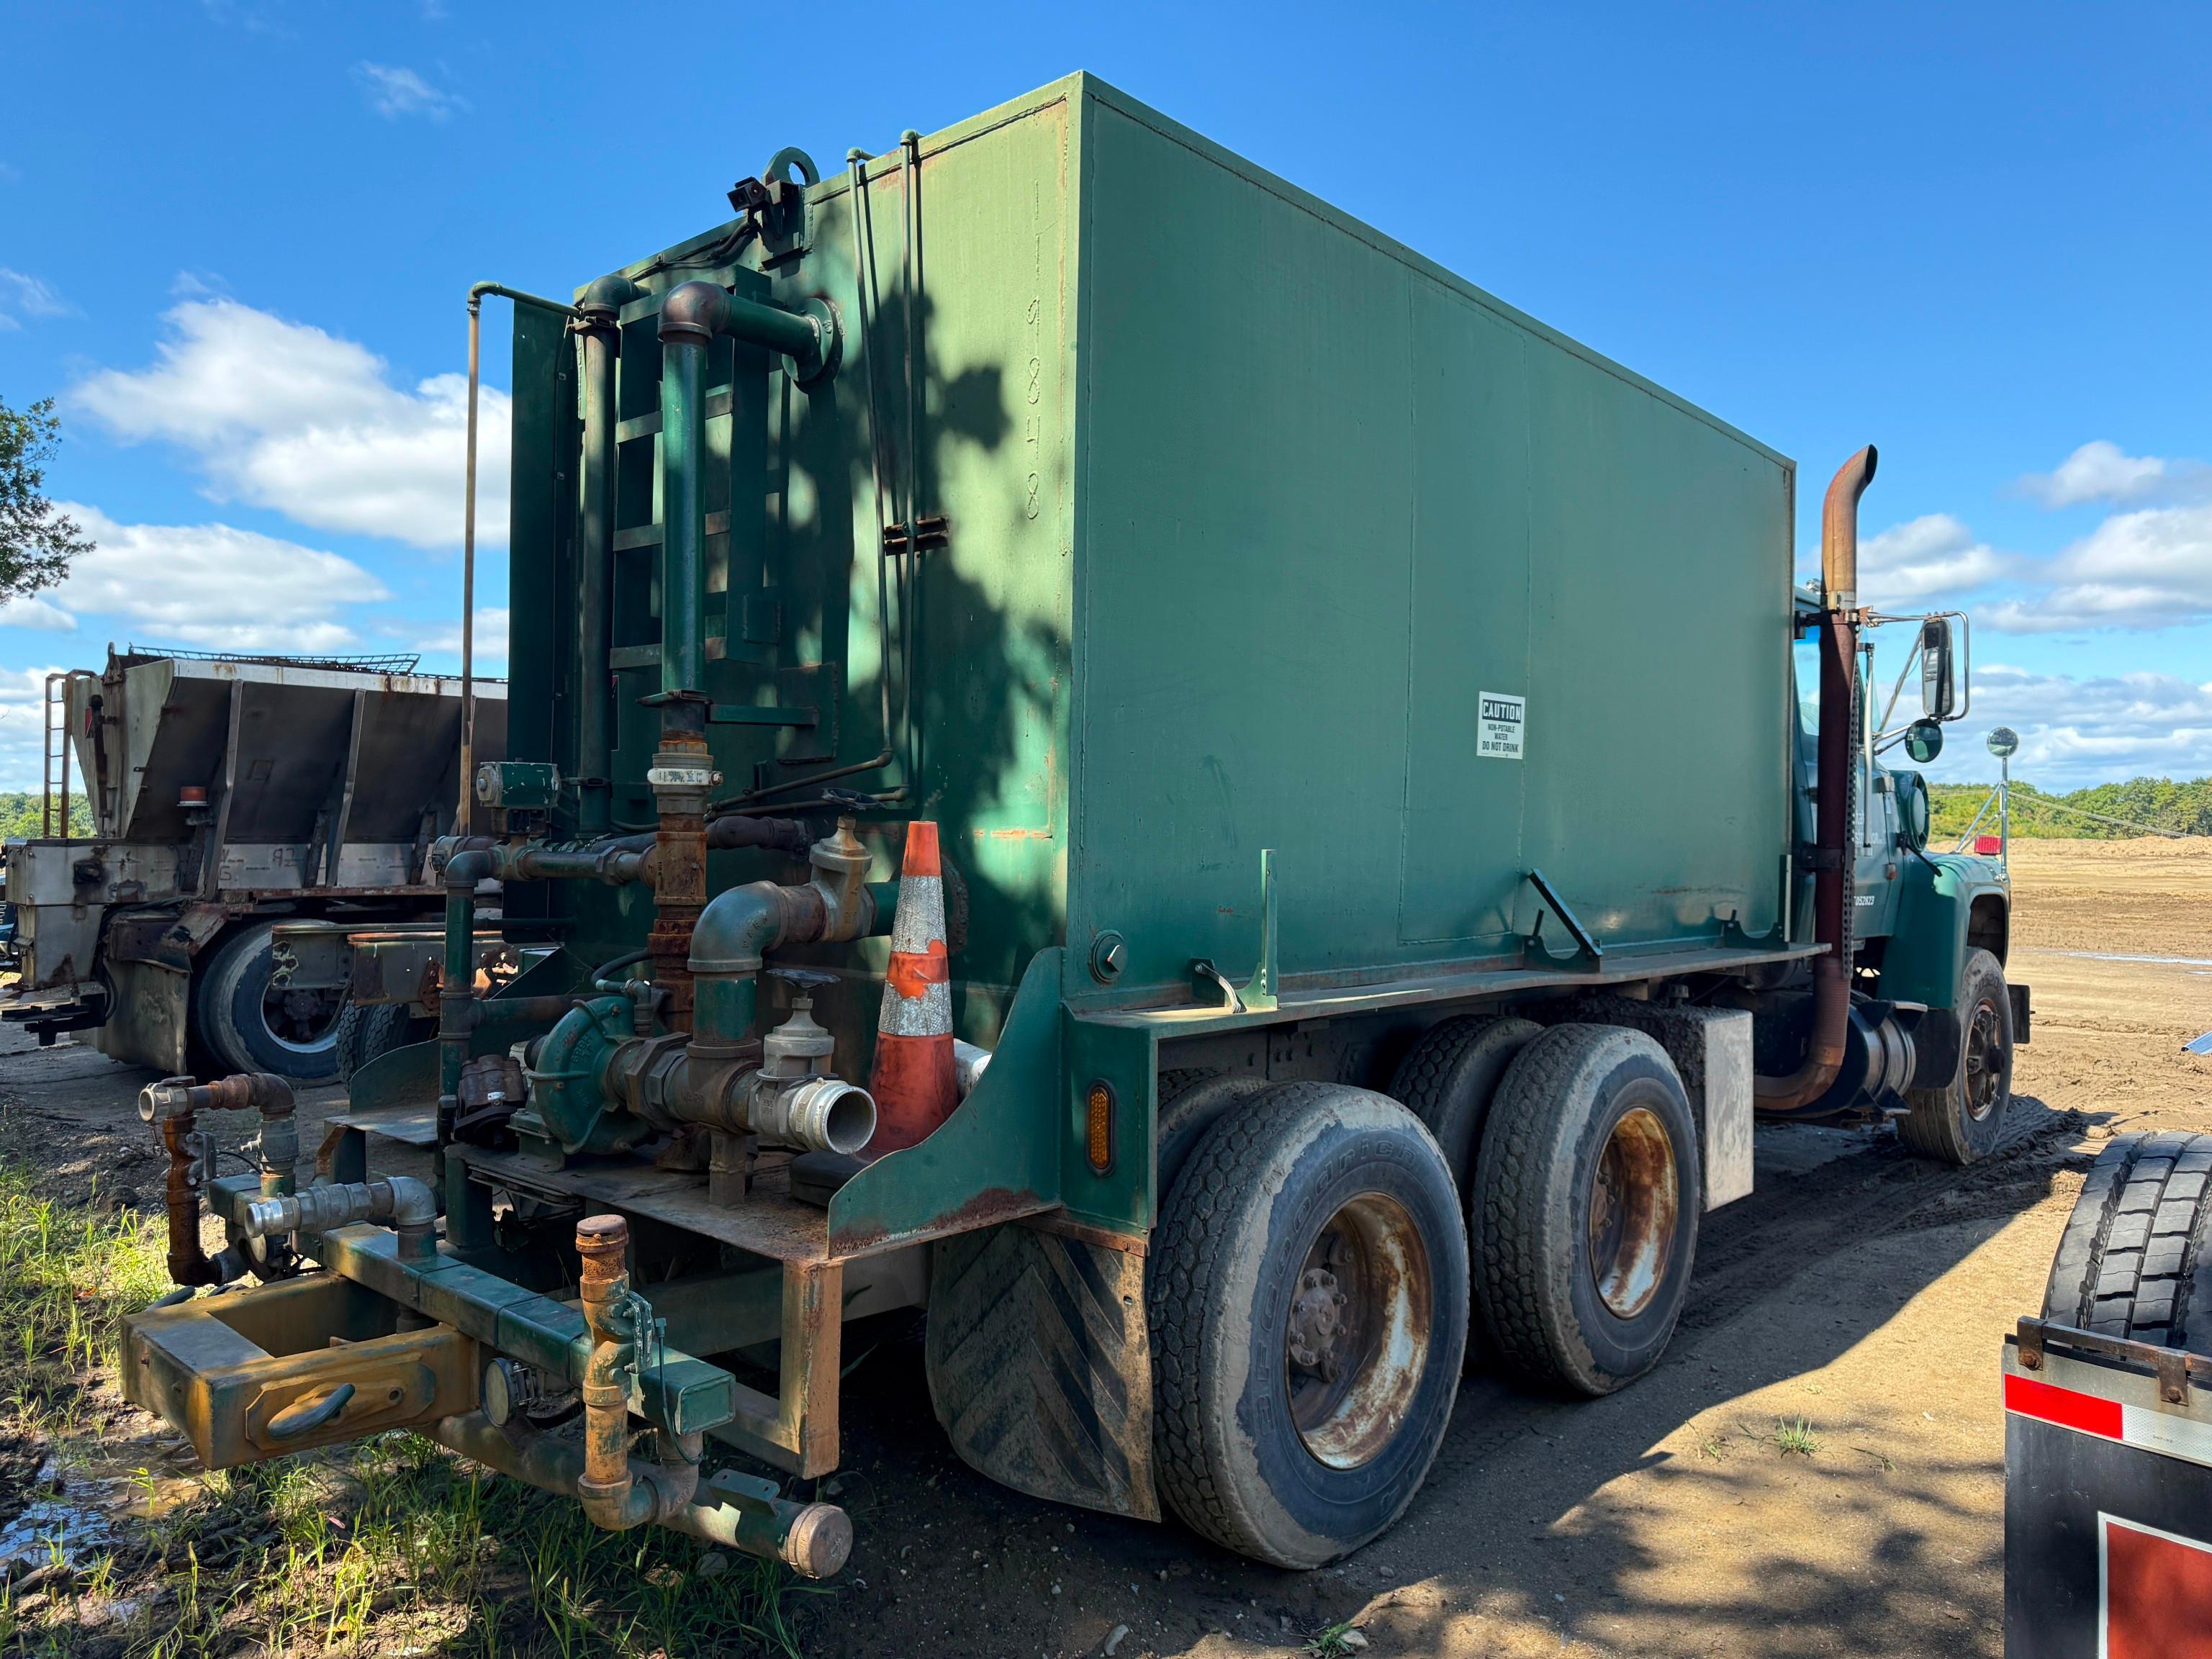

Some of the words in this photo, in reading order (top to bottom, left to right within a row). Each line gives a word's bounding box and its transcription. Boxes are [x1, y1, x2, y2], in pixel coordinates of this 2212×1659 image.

[1483, 702, 1521, 720] CAUTION
[1487, 723, 1515, 733] NON-POTABLE
[1482, 741, 1490, 751] DO
[1491, 741, 1502, 752] NOT
[1502, 743, 1519, 753] DRINK
